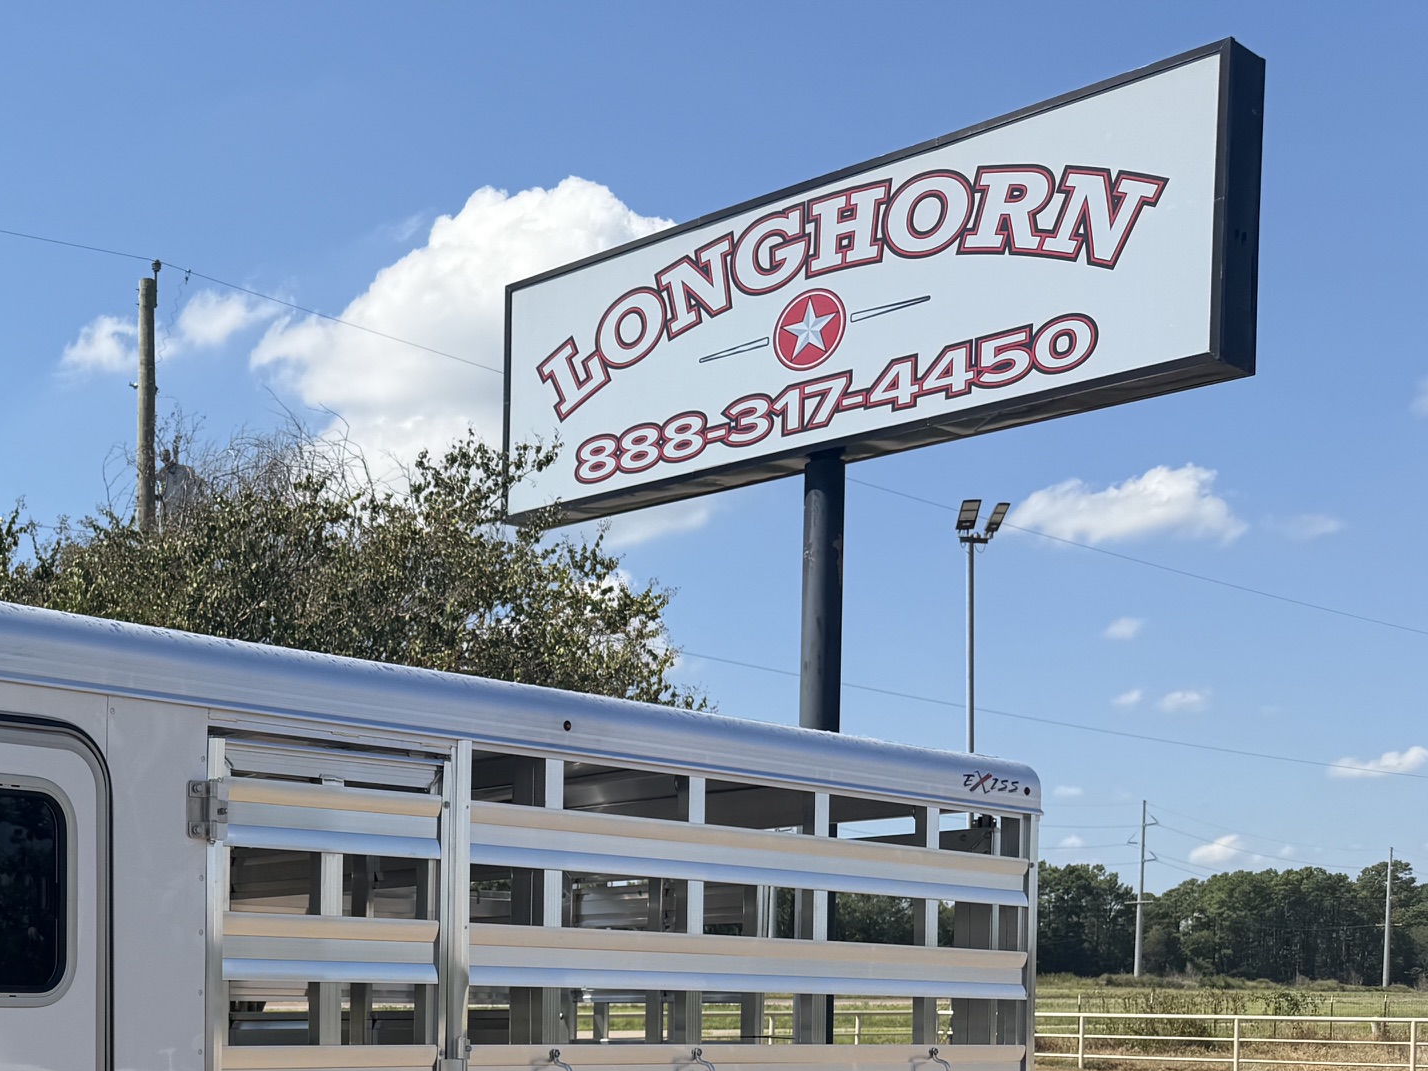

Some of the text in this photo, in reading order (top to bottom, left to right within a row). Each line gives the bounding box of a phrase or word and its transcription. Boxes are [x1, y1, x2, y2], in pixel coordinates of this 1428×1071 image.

[536, 164, 1170, 422] LONGHORN
[574, 312, 1099, 485] 888-317-4450
[963, 770, 1019, 794] EXISS
